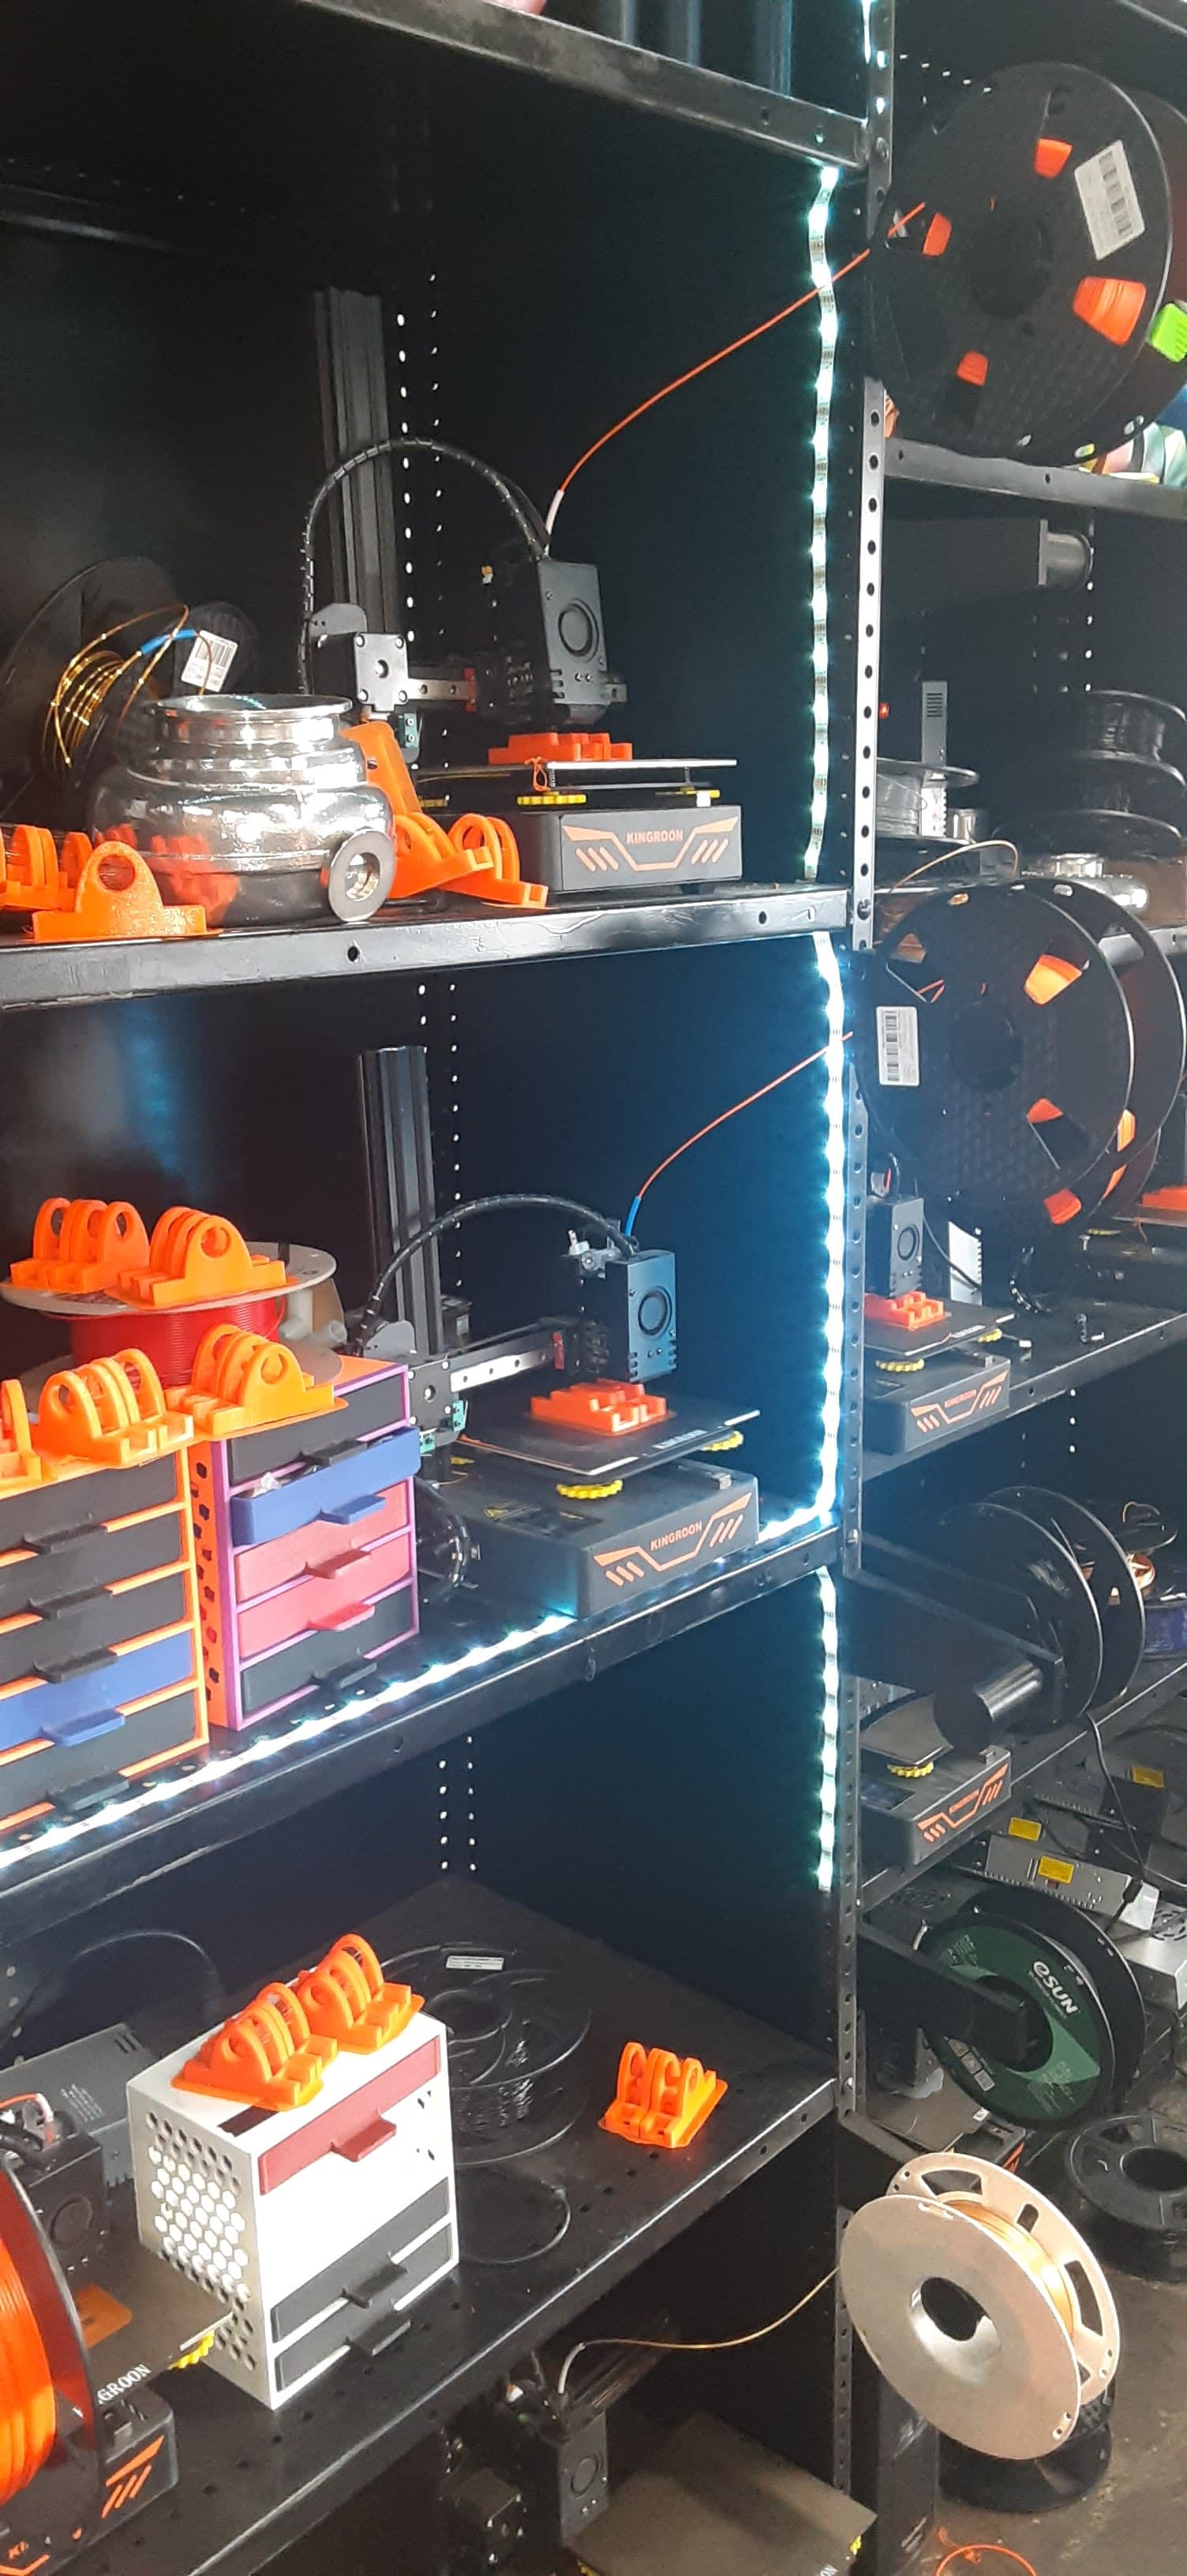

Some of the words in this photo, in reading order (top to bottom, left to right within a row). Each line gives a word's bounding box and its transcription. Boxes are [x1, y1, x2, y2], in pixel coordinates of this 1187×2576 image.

[626, 829, 683, 845] KINGROON
[650, 1521, 703, 1552] KINGROON
[96, 2363, 152, 2405] GROON
